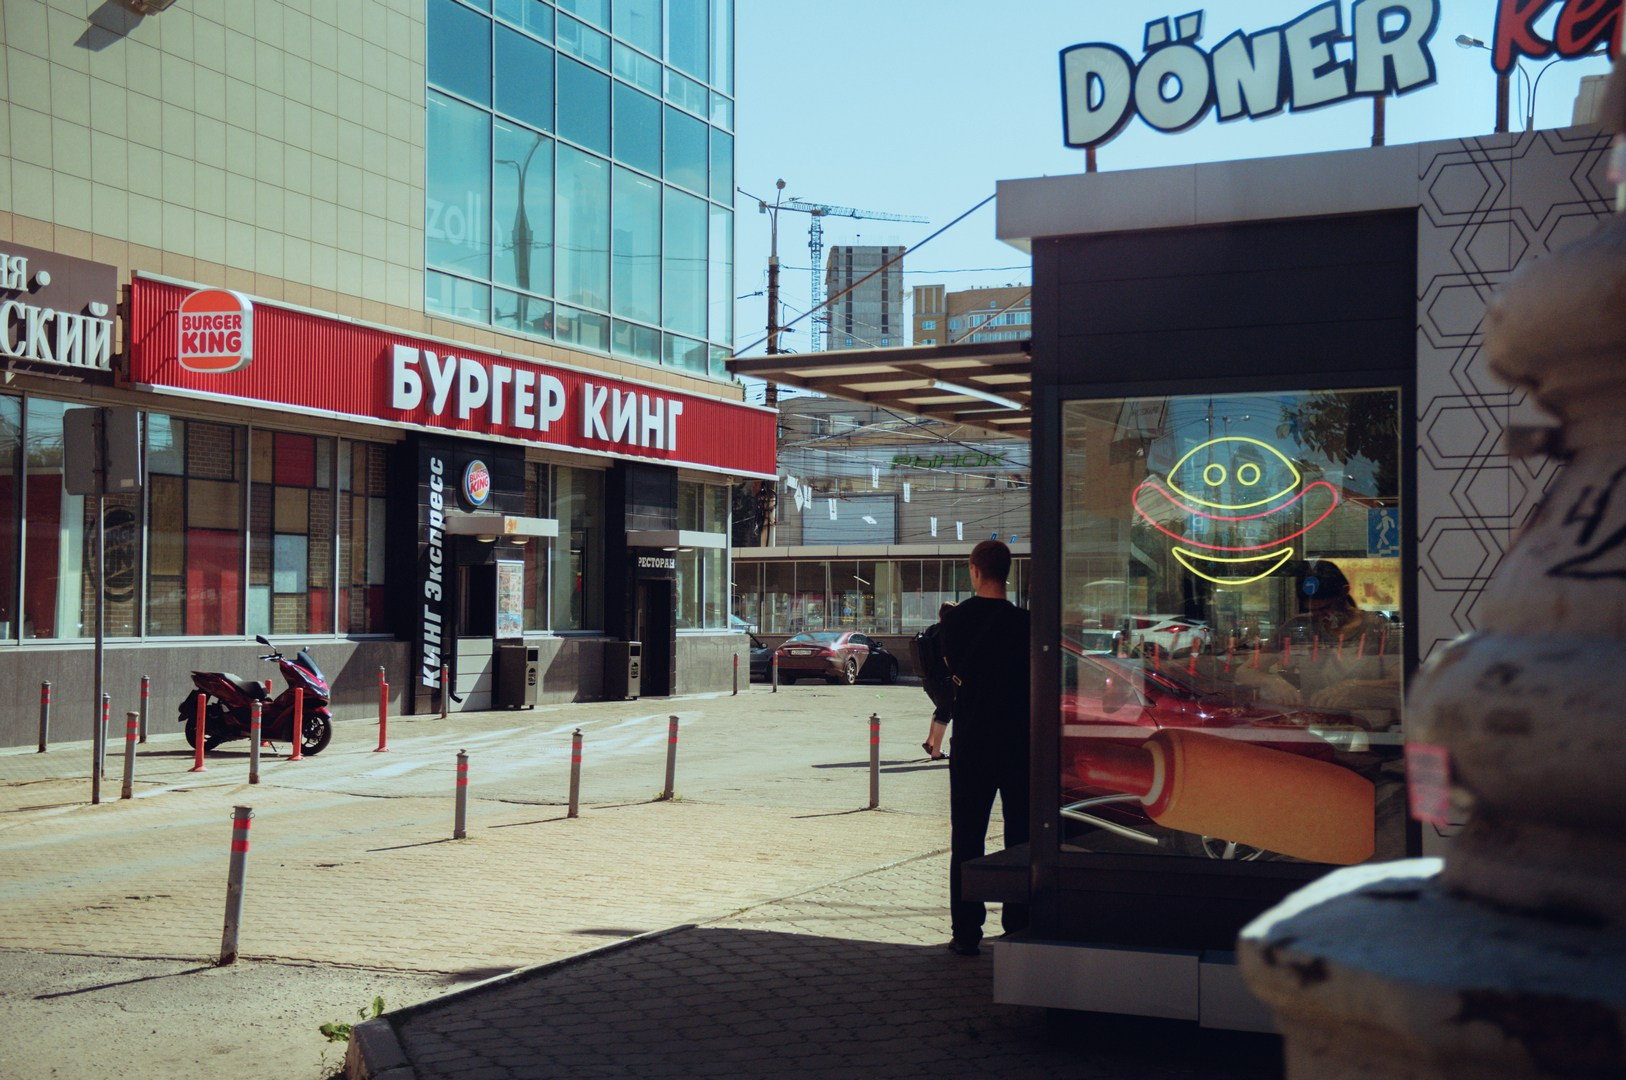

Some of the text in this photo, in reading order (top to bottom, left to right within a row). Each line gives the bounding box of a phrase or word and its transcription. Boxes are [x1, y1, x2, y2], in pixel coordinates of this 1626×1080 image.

[1059, 0, 1440, 149] DÖNER
[182, 314, 242, 331] BURGER
[0, 300, 113, 371] СКИЙ
[182, 331, 242, 354] KING
[390, 343, 683, 452] БУРГЕР КИНГ
[891, 451, 1007, 470] РЫНОК
[470, 476, 489, 494] KING
[422, 457, 446, 689] КИНГ Экспресс
[638, 556, 675, 569] РЕСТОРАН
